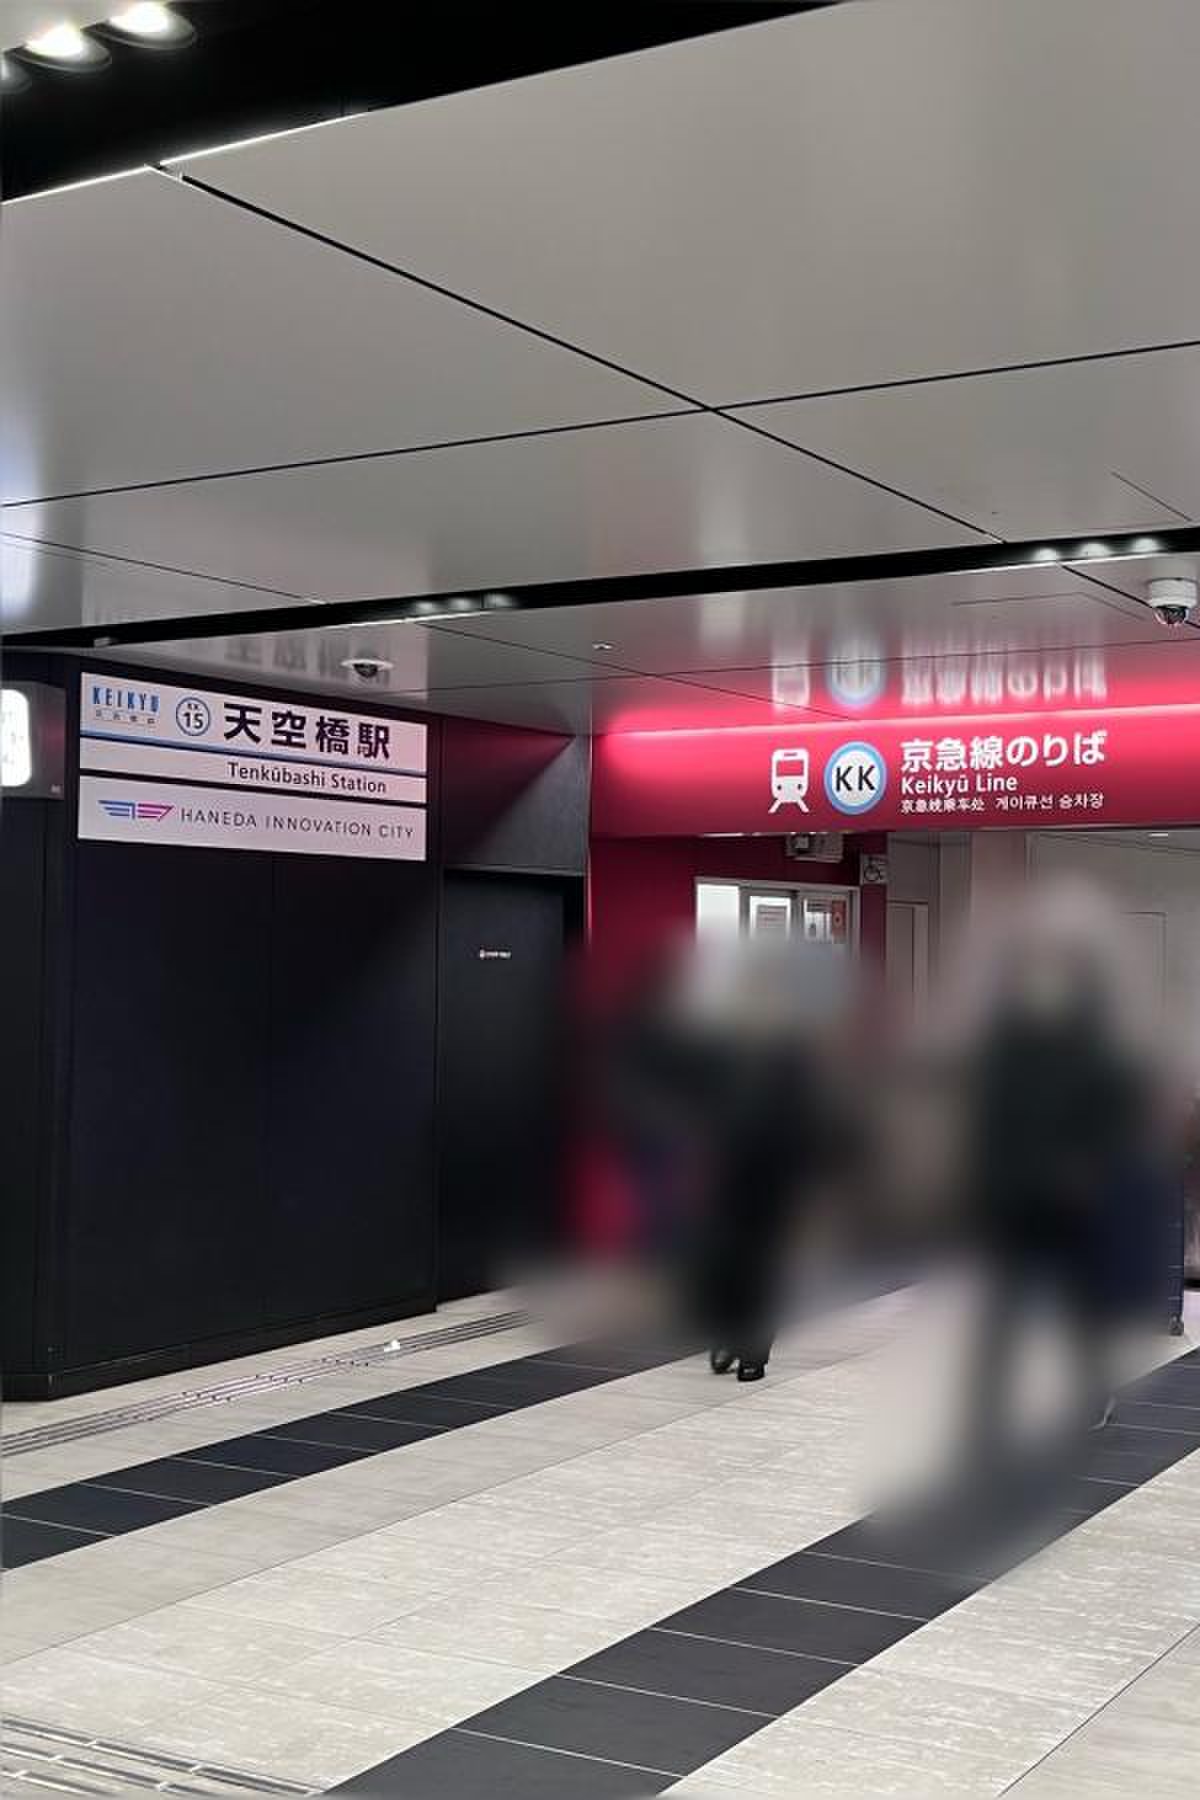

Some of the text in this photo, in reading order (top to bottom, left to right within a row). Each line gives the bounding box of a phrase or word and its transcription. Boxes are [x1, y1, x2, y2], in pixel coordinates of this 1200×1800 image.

[92, 687, 160, 712] KEIKYU
[183, 712, 204, 729] 15
[223, 702, 390, 759] 天空橋駅
[900, 730, 1108, 773] 京急線のりば
[227, 761, 387, 794] Tenkūbashi Station
[835, 765, 876, 792] KK
[900, 772, 1019, 798] Keikyū Line
[1058, 793, 1104, 809] 승차장
[180, 807, 414, 839] HANEDA INNOVATION CITY
